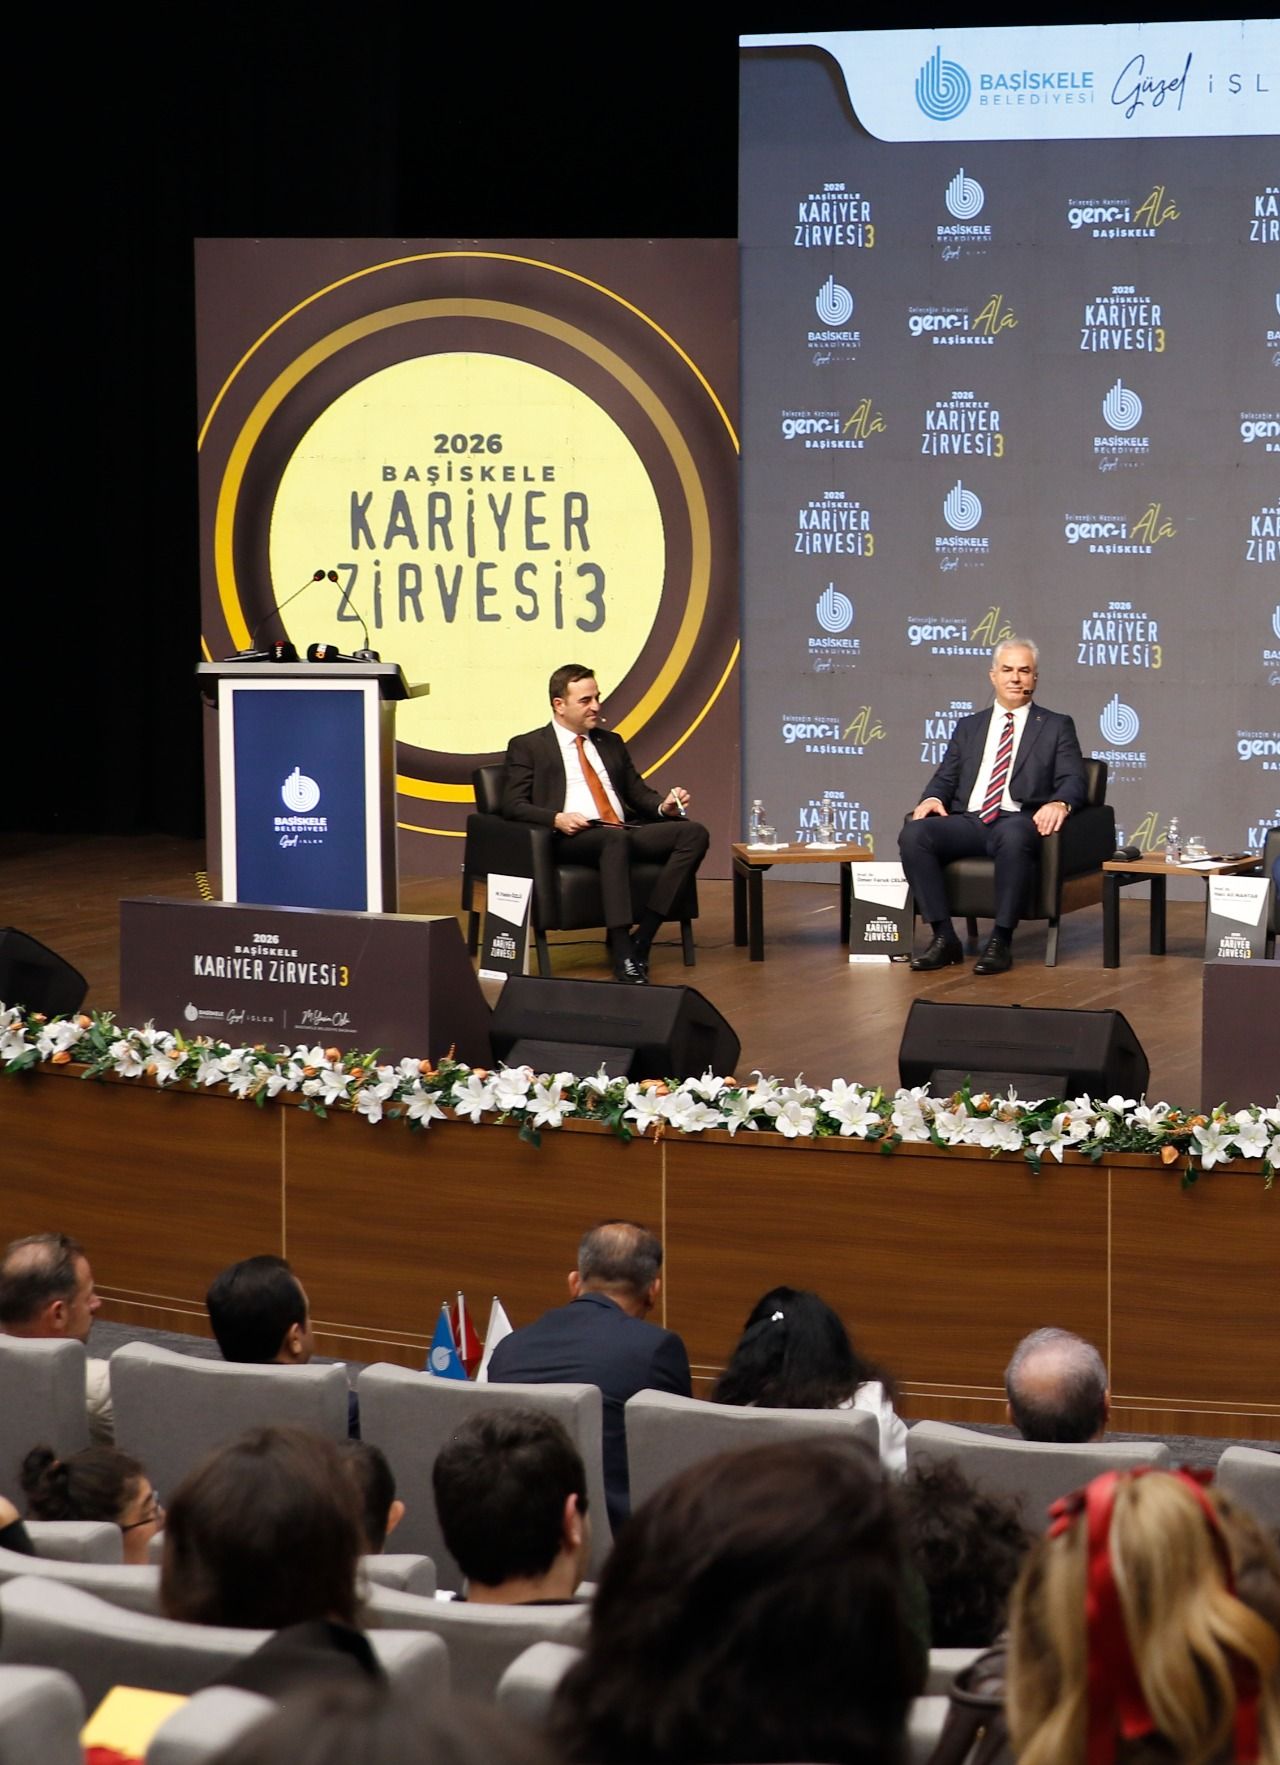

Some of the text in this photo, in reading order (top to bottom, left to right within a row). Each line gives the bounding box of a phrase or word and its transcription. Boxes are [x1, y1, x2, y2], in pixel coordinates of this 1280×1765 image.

[981, 70, 1093, 91] BAŞİSKELE
[1111, 52, 1192, 119] Güzel
[980, 91, 1093, 105] BELEDİYESİ
[824, 183, 845, 191] 2026
[799, 201, 870, 225] KARİYER
[938, 225, 991, 235] BAŞİSKELE
[1093, 228, 1155, 238] BAŞİSKELE
[1112, 286, 1134, 294] 2026
[1086, 303, 1160, 329] KARİYER
[808, 331, 859, 340] BAŞİSKELE
[933, 335, 993, 344] BAŞİSKELE
[927, 410, 999, 434] KARİYER
[433, 433, 503, 454] 2026
[1094, 436, 1149, 448] BAŞİSKELE
[382, 460, 556, 487] BAŞİSKELE
[349, 488, 591, 558] KARİYER
[798, 509, 869, 534] KARİYER
[936, 536, 988, 549] BAŞİSKELE
[1090, 544, 1151, 554] BAŞİSKELE
[1109, 602, 1131, 610] 2026
[1081, 620, 1157, 645] KARİYER
[809, 638, 859, 648] BAŞİSKELE
[932, 646, 991, 655] BAŞİSKELE
[950, 701, 973, 710] 2026
[806, 745, 863, 754] BAŞİSKELE
[1092, 750, 1146, 761] BAŞİSKELE
[824, 791, 845, 799] 2026
[274, 816, 328, 826] BAŞİSKELE
[800, 807, 870, 831] KAİYER
[253, 934, 279, 944] 2026
[234, 945, 298, 958] BAŞİSKELE
[194, 955, 263, 982] KARİYER
